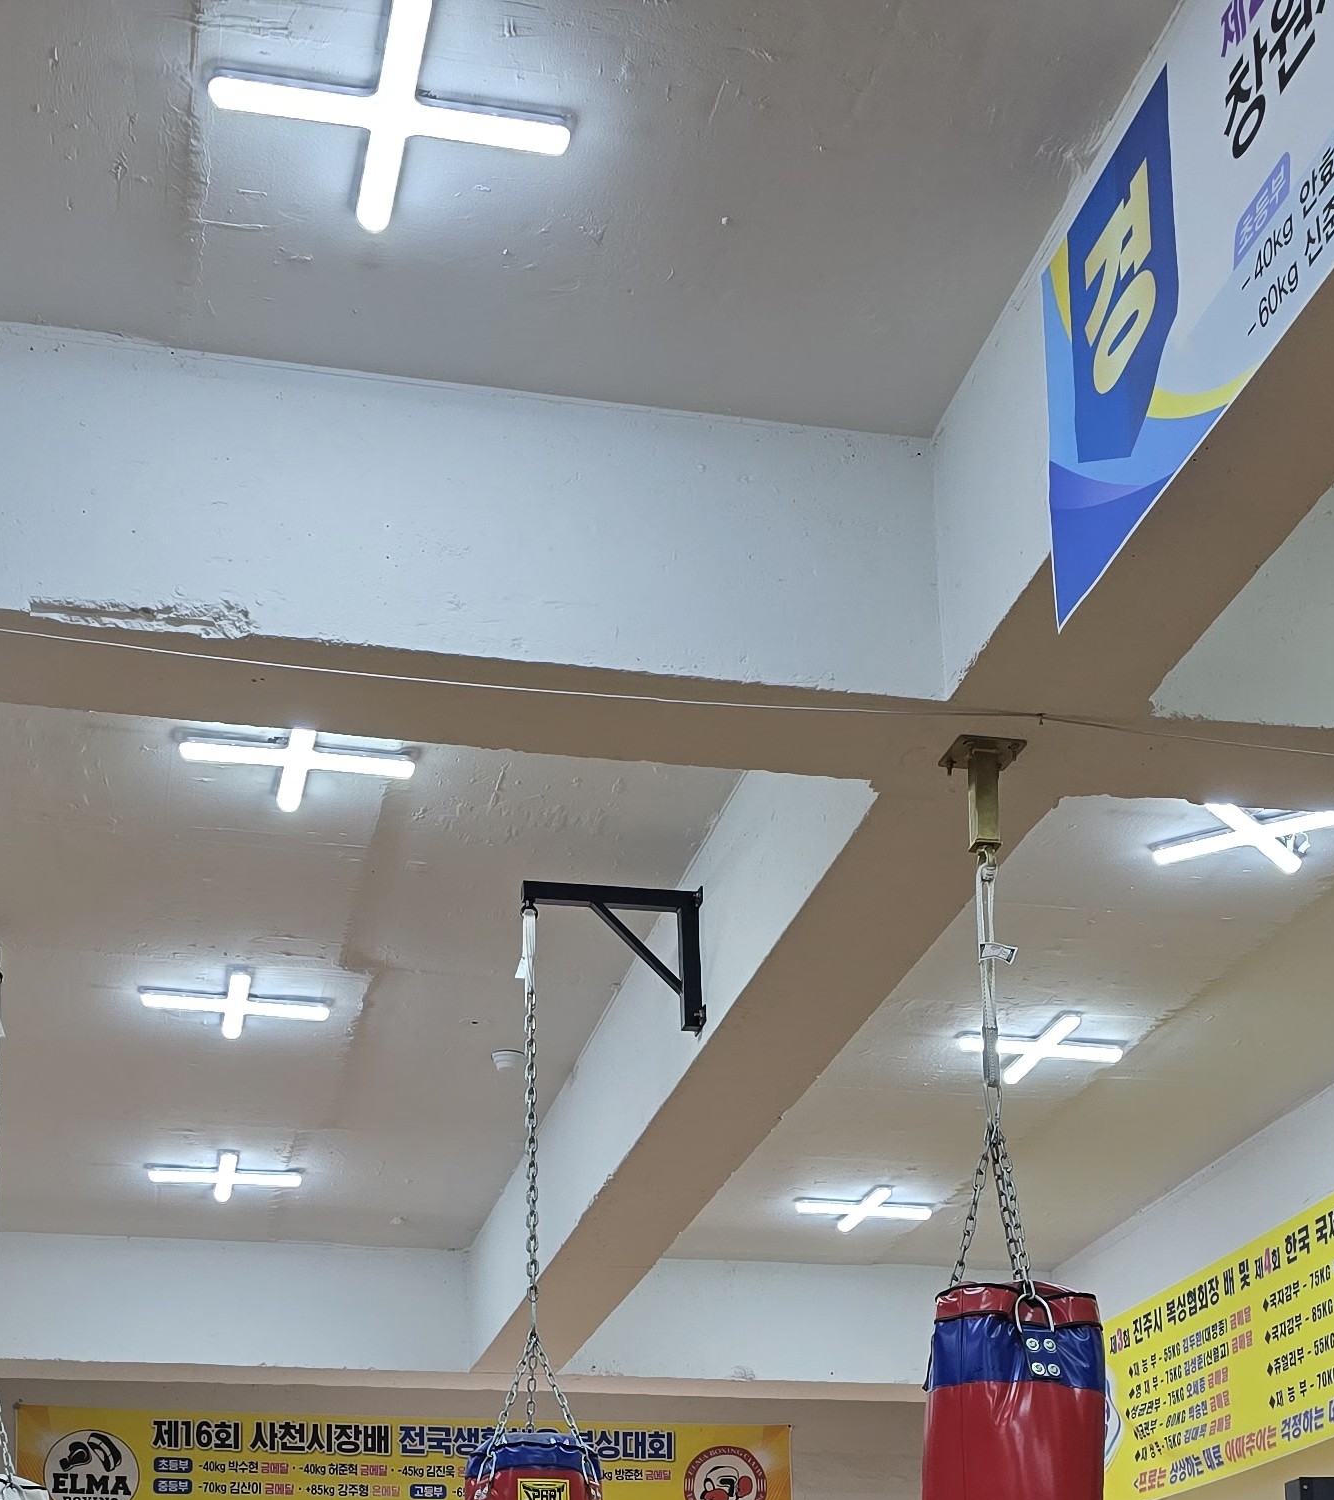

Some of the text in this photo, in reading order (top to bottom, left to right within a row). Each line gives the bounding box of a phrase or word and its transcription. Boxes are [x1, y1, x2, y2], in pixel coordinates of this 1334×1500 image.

[1221, 0, 1265, 58] 제
[1224, 0, 1326, 159] 창원
[1238, 163, 1287, 249] 초등부
[1084, 157, 1157, 394] 경
[1110, 1327, 1131, 1355] 제3회
[1132, 1306, 1163, 1344] 진주시
[1166, 1276, 1220, 1326] 복싱협회장
[1223, 1265, 1236, 1296] 배
[1254, 1247, 1281, 1281] 제4회
[1284, 1223, 1310, 1265] 한국
[1268, 1280, 1300, 1309] 국자감부
[1309, 1264, 1331, 1290] 75KG
[1270, 1313, 1302, 1342] 국자감부
[1311, 1298, 1334, 1323] 85KG
[151, 1419, 242, 1450] 제16회
[249, 1421, 391, 1455] 사천시장배
[1280, 1405, 1326, 1443] 걱정하는
[52, 1472, 132, 1496] ELMA
[156, 1459, 190, 1472] 초등부
[198, 1462, 226, 1474] -40kg
[228, 1460, 258, 1474] 박수현
[260, 1462, 290, 1475] 금메달
[298, 1464, 326, 1476] -40kg
[360, 1464, 388, 1477] 금메달
[397, 1465, 424, 1478] -45kg
[426, 1464, 455, 1478] 김진욱
[157, 1480, 190, 1493] 중등부
[198, 1483, 227, 1495] -70kg
[229, 1481, 262, 1495] 김산이
[264, 1483, 294, 1496] 금메달
[305, 1484, 335, 1497] +85kg
[337, 1482, 369, 1497] 강주형
[413, 1485, 444, 1497] 고등부
